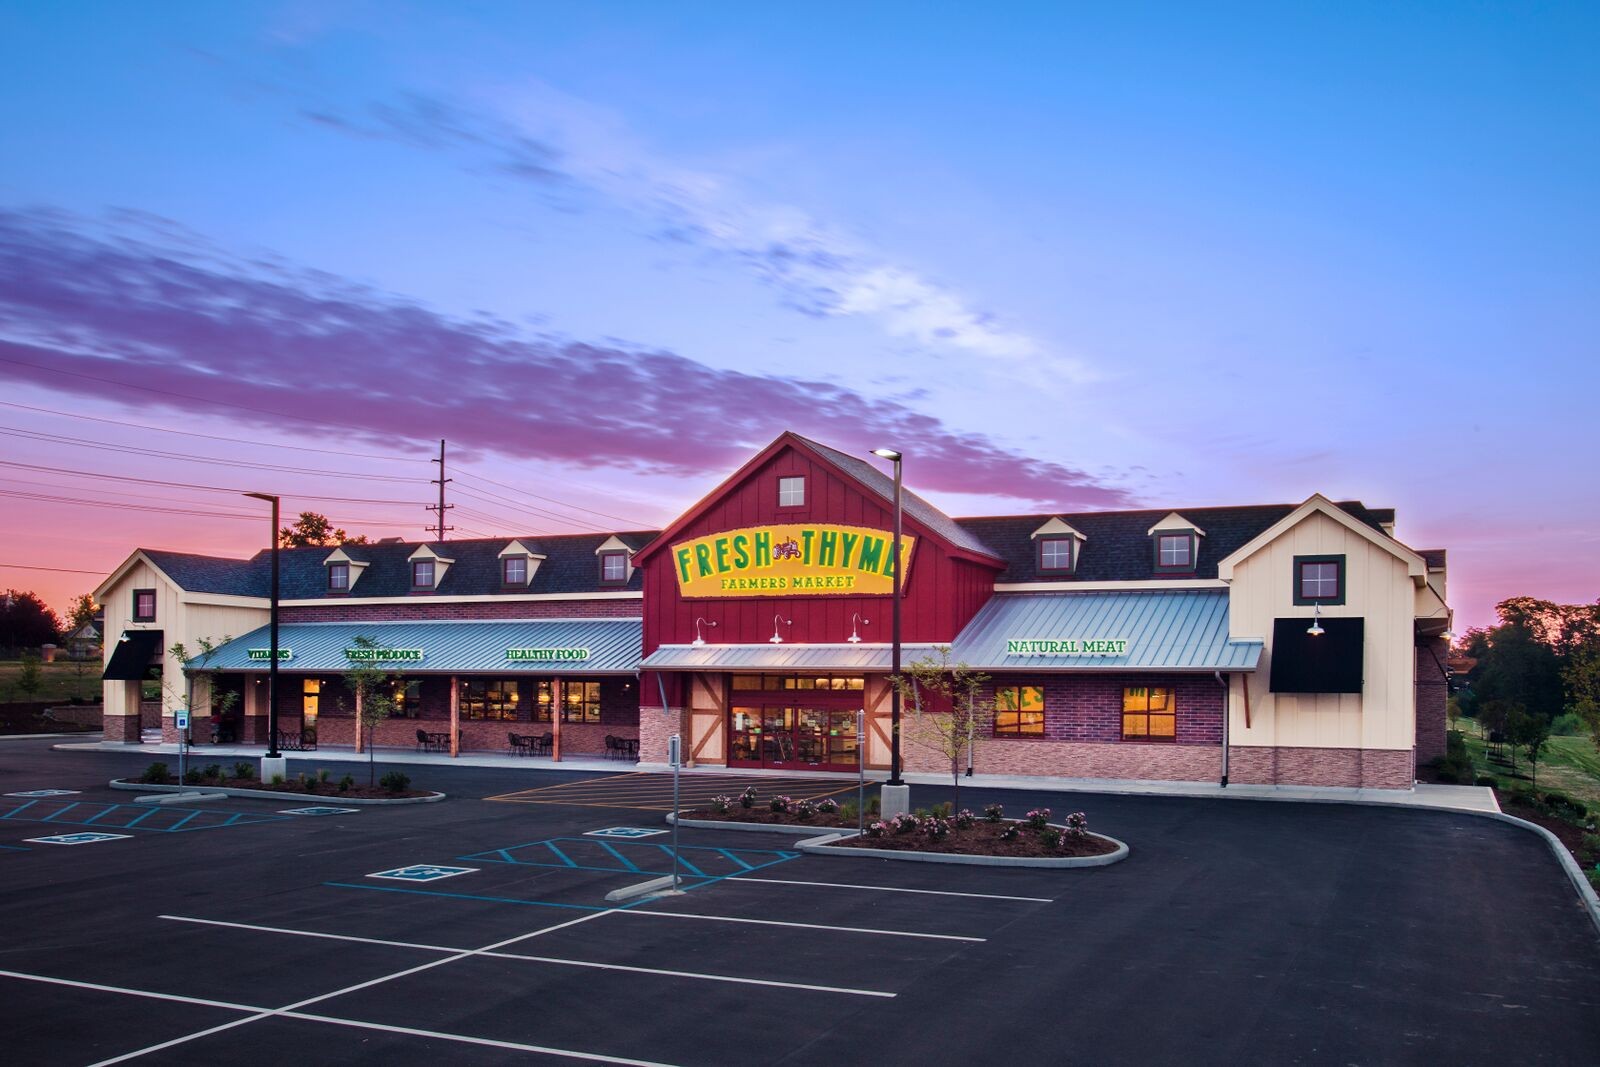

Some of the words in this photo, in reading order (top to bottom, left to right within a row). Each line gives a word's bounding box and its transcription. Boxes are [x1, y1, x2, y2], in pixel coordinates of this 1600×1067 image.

[677, 531, 771, 583] FRESH
[721, 577, 786, 589] FARMERS
[792, 576, 854, 588] MARKET
[1008, 641, 1078, 653] NATURAL
[1082, 641, 1126, 653] MEAT
[376, 650, 421, 660] PRODUCE
[506, 649, 555, 660] HEALTHY
[556, 649, 588, 660] FOOD
